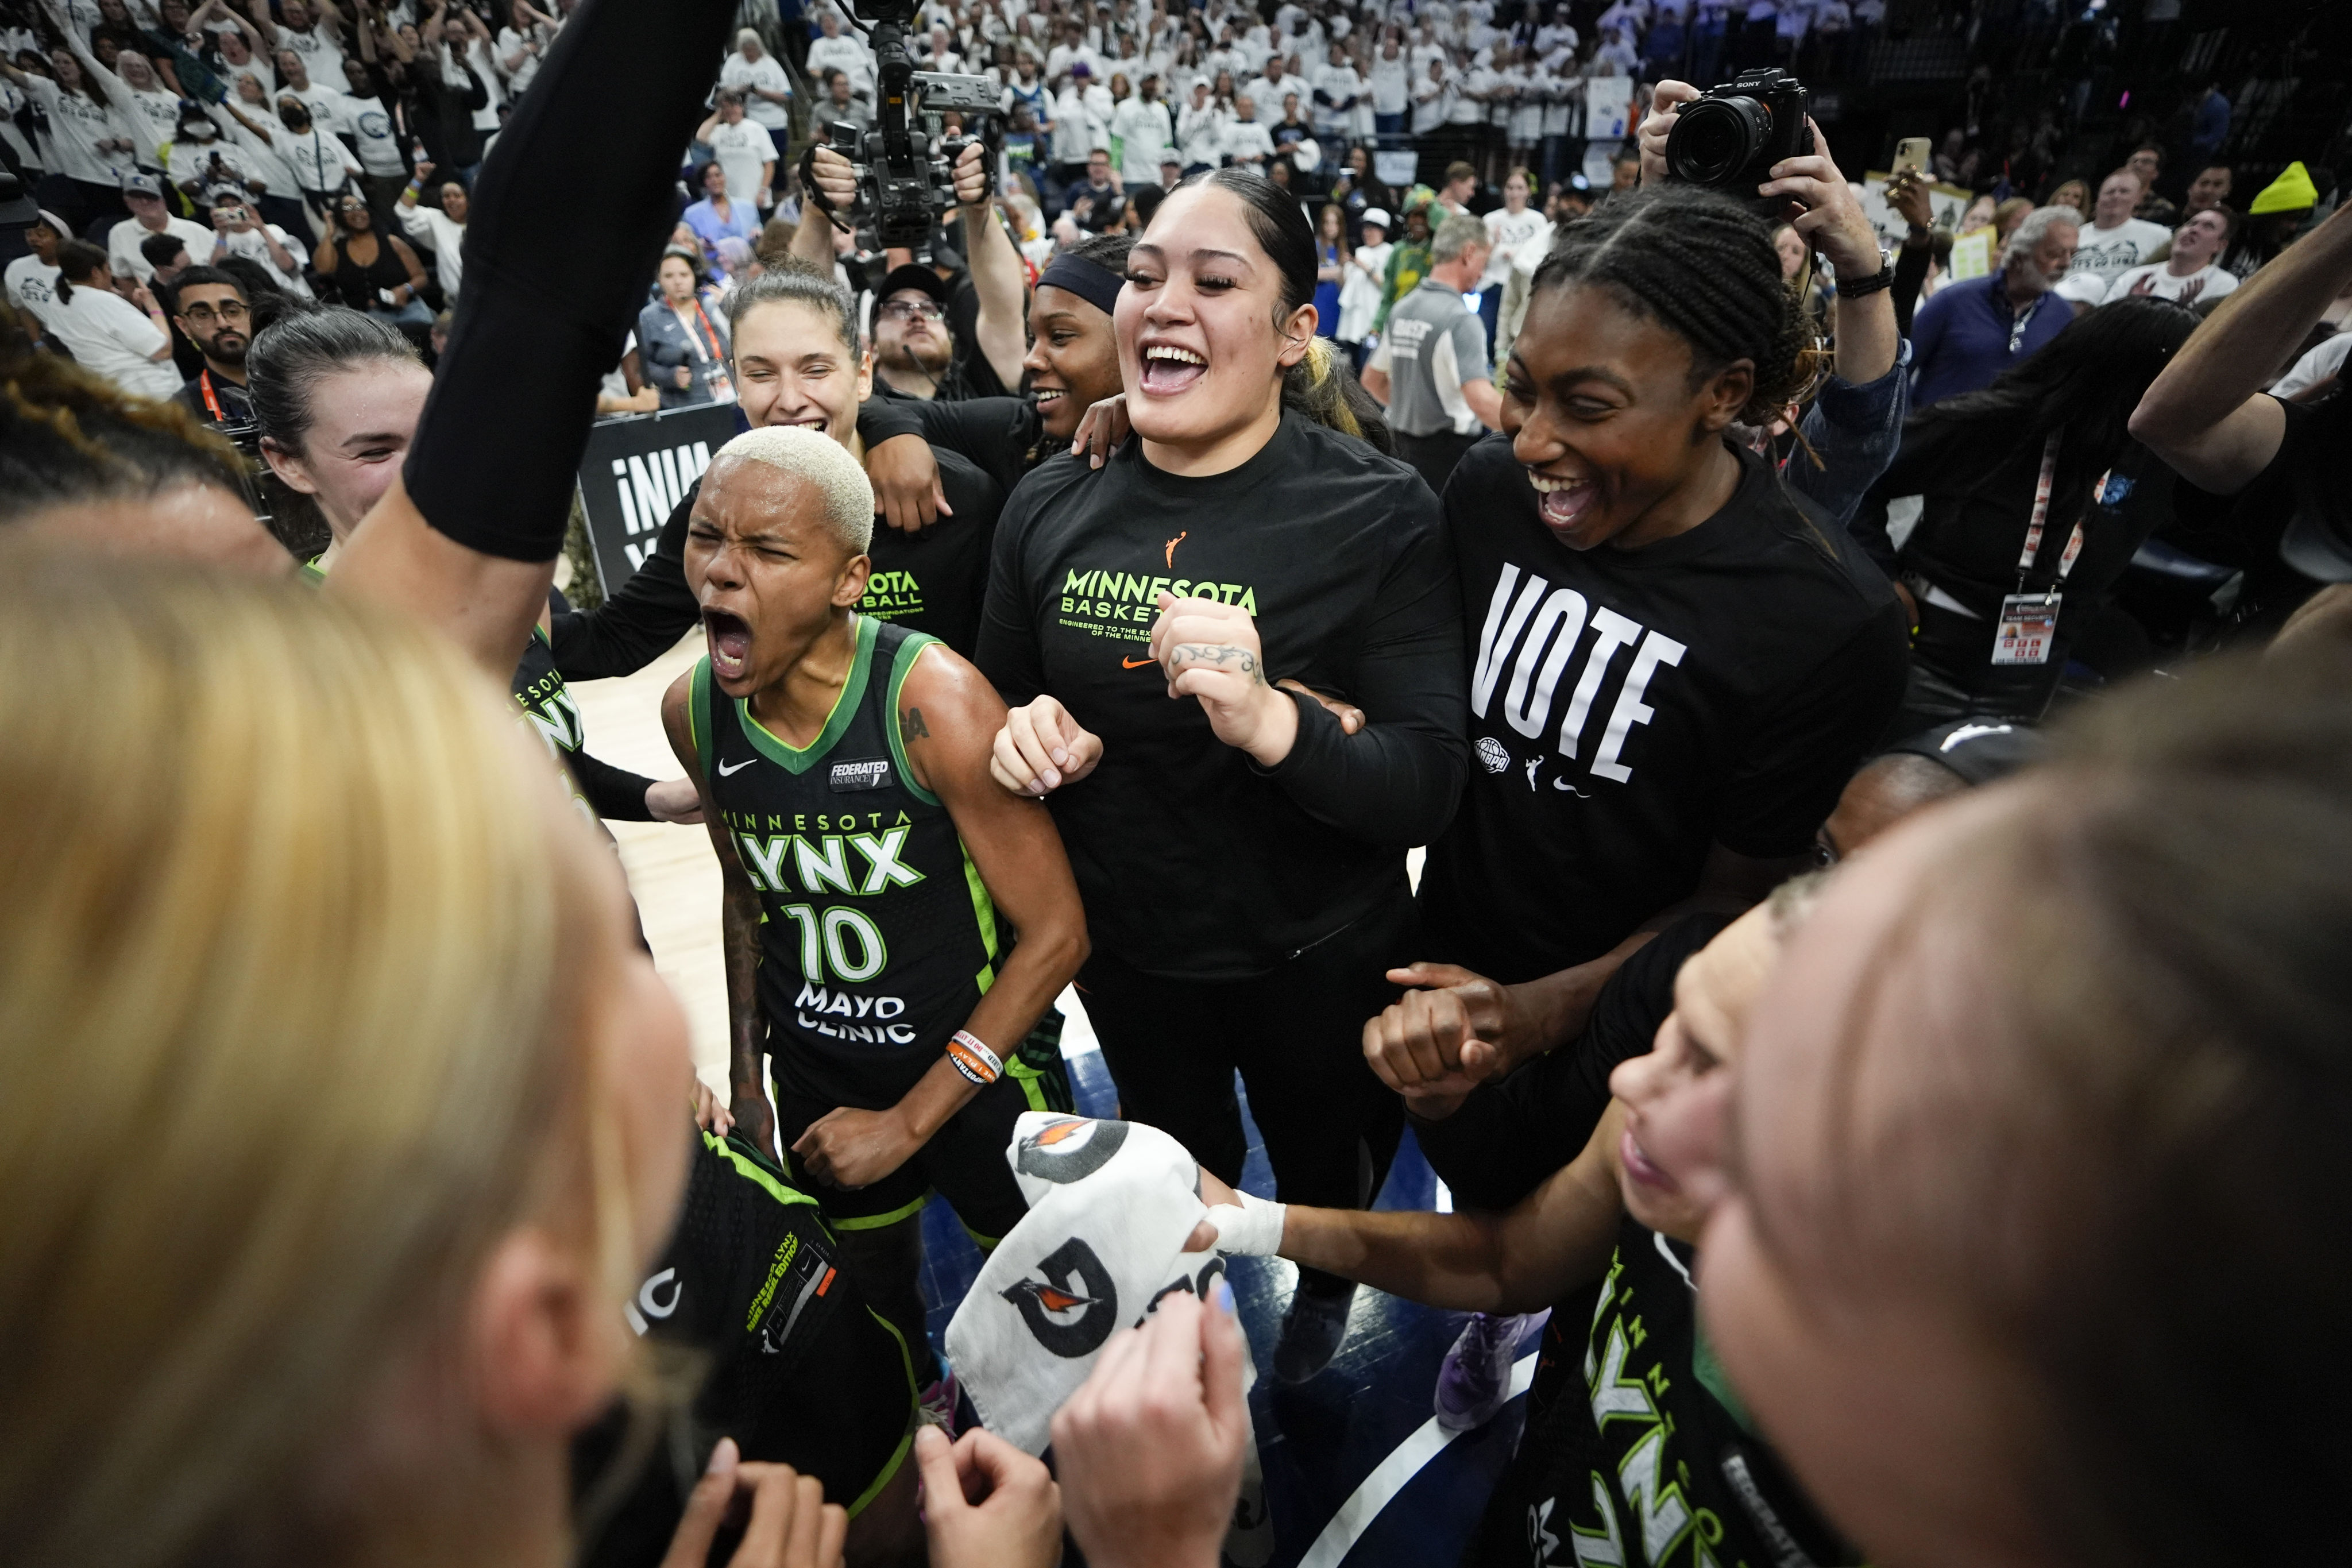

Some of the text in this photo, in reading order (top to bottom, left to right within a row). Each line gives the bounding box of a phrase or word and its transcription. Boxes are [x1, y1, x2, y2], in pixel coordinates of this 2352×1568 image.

[1059, 618, 1104, 631] ENGINEERED
[1120, 627, 1138, 635] THE
[1104, 631, 1122, 640] THE
[1472, 562, 1687, 783] VOTE
[830, 774, 869, 785] INSURANCE
[831, 761, 889, 777] FEDERATED
[720, 809, 912, 831] MINNESOTA
[780, 903, 887, 984] 10
[794, 982, 905, 1018] MAYO
[798, 1011, 916, 1044] CLINIC
[959, 1051, 978, 1068] PLAY
[775, 1231, 794, 1261] LYNX
[747, 1306, 764, 1332] NIKE
[762, 1277, 779, 1309] REBEL
[775, 1237, 798, 1278] EDITION
